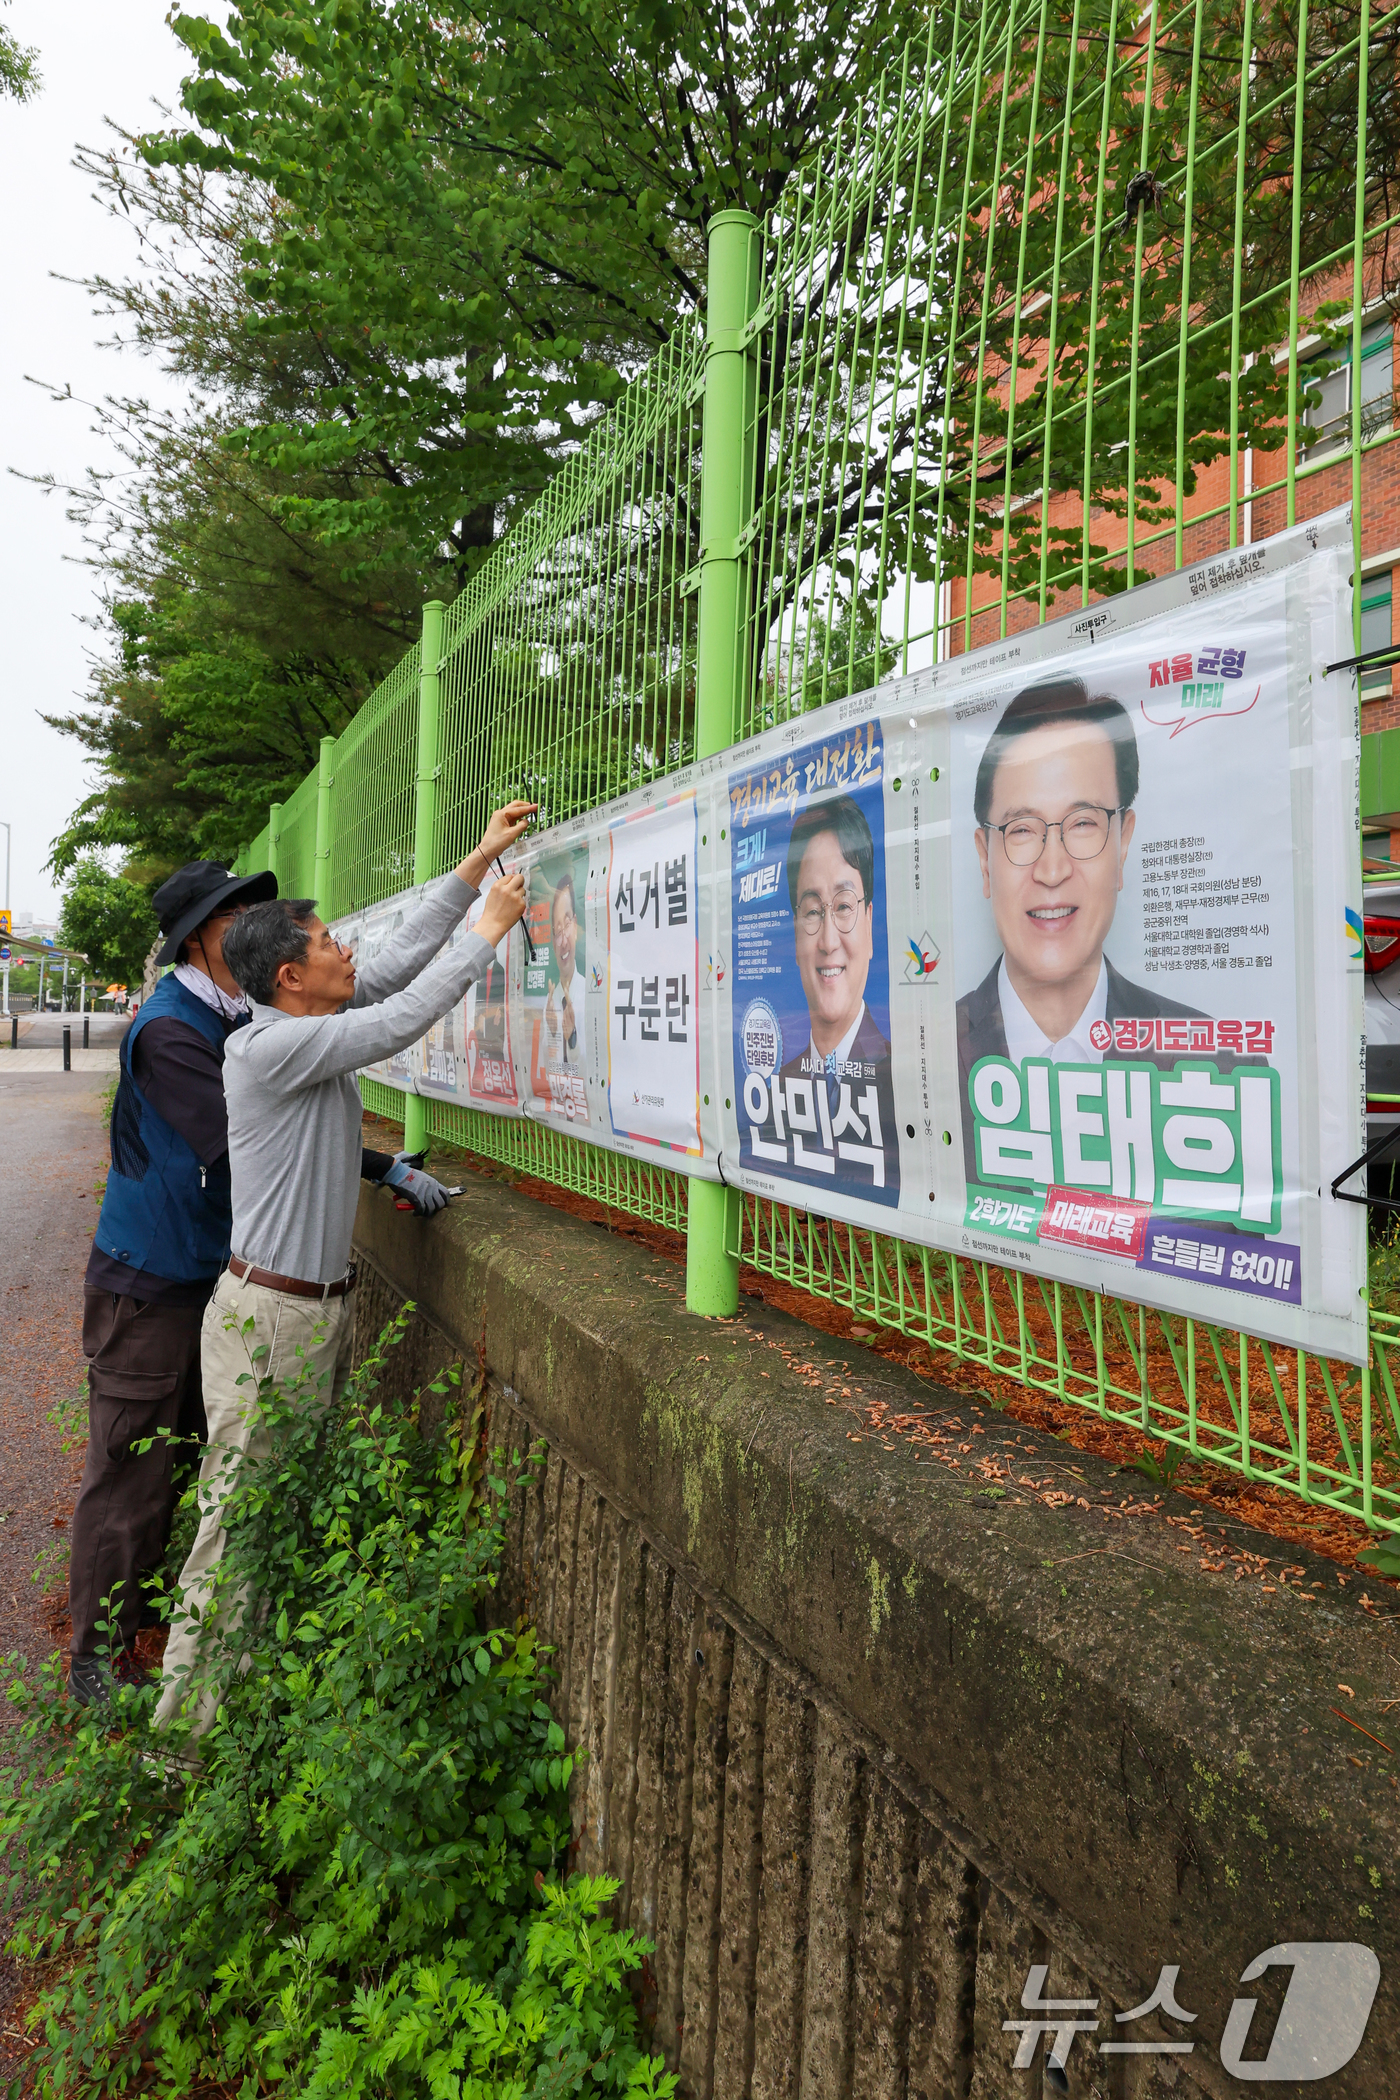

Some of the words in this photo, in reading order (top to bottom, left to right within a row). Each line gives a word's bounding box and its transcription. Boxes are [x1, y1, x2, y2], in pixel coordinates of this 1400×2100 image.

[1188, 570, 1205, 584] 띠지
[1207, 562, 1224, 577] 제거
[1227, 558, 1236, 569] 후
[1239, 547, 1266, 564] 덮개를
[1190, 580, 1207, 596] 덮어
[1209, 560, 1265, 588] 접착하십시오.
[1074, 614, 1107, 634] 사진투입구
[960, 659, 988, 676] 점선까지만
[989, 652, 1007, 665] 테이프
[1008, 648, 1021, 660] 부착
[1148, 653, 1193, 688] 자율
[1197, 646, 1247, 679] 균형
[1181, 682, 1224, 708] 미래
[955, 700, 998, 721] 경기도교육감선거
[730, 757, 800, 828] 경기교육
[804, 722, 882, 793] 대전환
[736, 828, 767, 870] 크게!
[1141, 839, 1178, 854] 국립한경대
[1179, 836, 1205, 849] 총장(전)
[1142, 856, 1163, 869] 청와대
[1164, 851, 1213, 865] 대통령실장(전)
[738, 861, 782, 904] 제대로!
[1142, 870, 1179, 883] 고용노동부
[1180, 867, 1206, 880] 장관(전)
[1142, 888, 1160, 898] 제16,
[1161, 887, 1171, 897] 17,
[1172, 884, 1189, 895] 18대
[1190, 878, 1240, 893] 국회의원(성남
[1241, 875, 1262, 888] 분당)
[615, 854, 687, 933] 선거별
[1143, 901, 1174, 913] 외환은행,
[1175, 894, 1240, 910] 재무부·재정경제부
[1241, 892, 1270, 903] 근무(전)
[1143, 916, 1172, 928] 공군중위
[1173, 914, 1189, 926] 전역
[1144, 930, 1181, 942] 서울대학교
[1181, 928, 1204, 940] 대학원
[1205, 925, 1248, 940] 졸업(경영학
[1249, 924, 1269, 936] 석사)
[1144, 945, 1181, 957] 서울대학교
[1181, 943, 1212, 956] 경영학과
[1213, 942, 1229, 954] 졸업
[1144, 960, 1159, 972] 성남
[1160, 958, 1210, 971] 낙생초·양영중,
[1211, 957, 1227, 969] 서울
[1228, 956, 1254, 968] 경동고
[1255, 955, 1273, 968] 졸업
[615, 974, 689, 1042] 구분란
[746, 1032, 774, 1049] 민주진보
[1091, 1022, 1111, 1048] 현
[1114, 1019, 1276, 1054] 경기도교육감
[747, 1050, 775, 1067] 단일후보
[800, 1057, 824, 1074] AI시대
[825, 1048, 836, 1075] 첫
[837, 1061, 862, 1078] 교육감
[482, 1060, 514, 1096] 정옥선
[549, 1074, 588, 1121] 민경록
[743, 1072, 886, 1188] 안민석
[974, 1063, 1275, 1224] 임태희
[969, 1195, 1036, 1234] 2학기도
[1049, 1200, 1136, 1246] 미래교육
[1151, 1234, 1225, 1276] 흔들림
[1230, 1249, 1294, 1291] 없이!
[971, 1238, 999, 1255] 점선까지만
[999, 1246, 1018, 1260] 테이프
[1018, 1252, 1032, 1263] 부착
